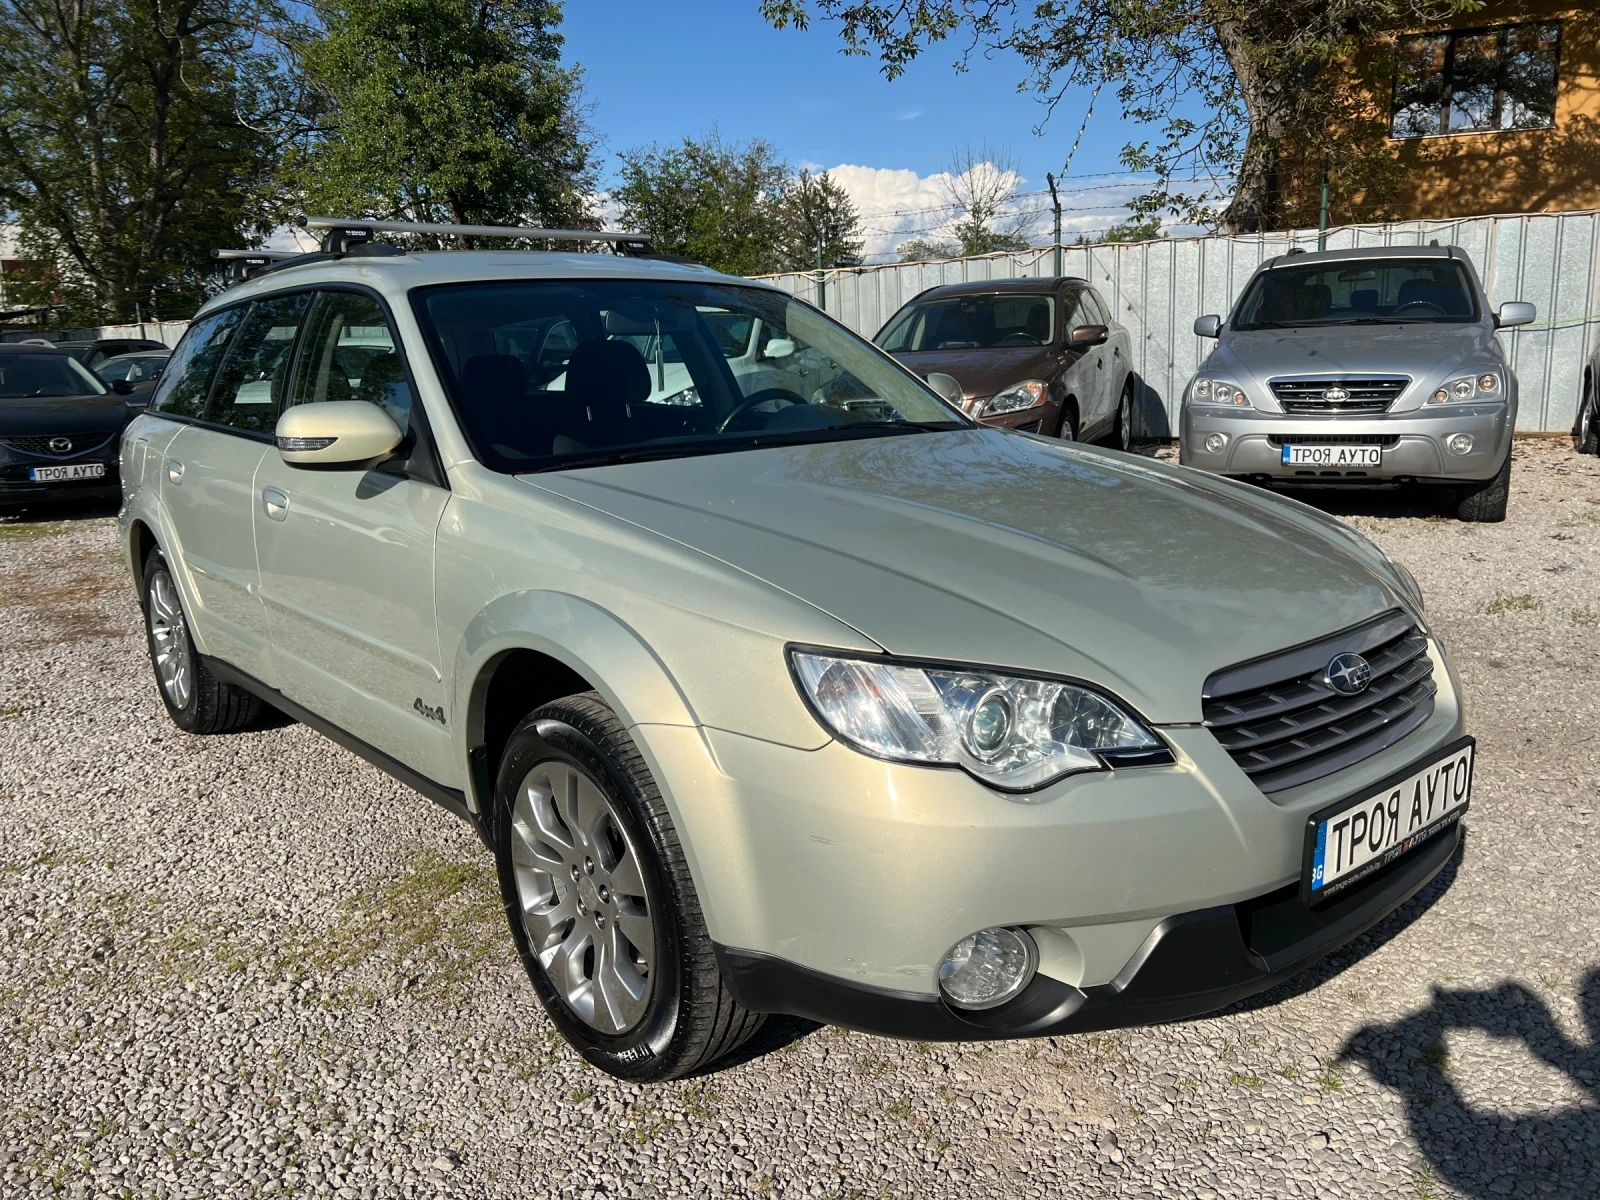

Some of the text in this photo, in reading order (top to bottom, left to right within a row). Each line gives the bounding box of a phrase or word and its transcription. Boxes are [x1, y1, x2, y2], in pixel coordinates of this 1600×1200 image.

[1292, 448, 1379, 463] ТРОЯ АУТО
[36, 467, 67, 480] ТРОЯ
[73, 465, 104, 478] АУТО
[1332, 755, 1468, 874] ТРОЯ АУТО
